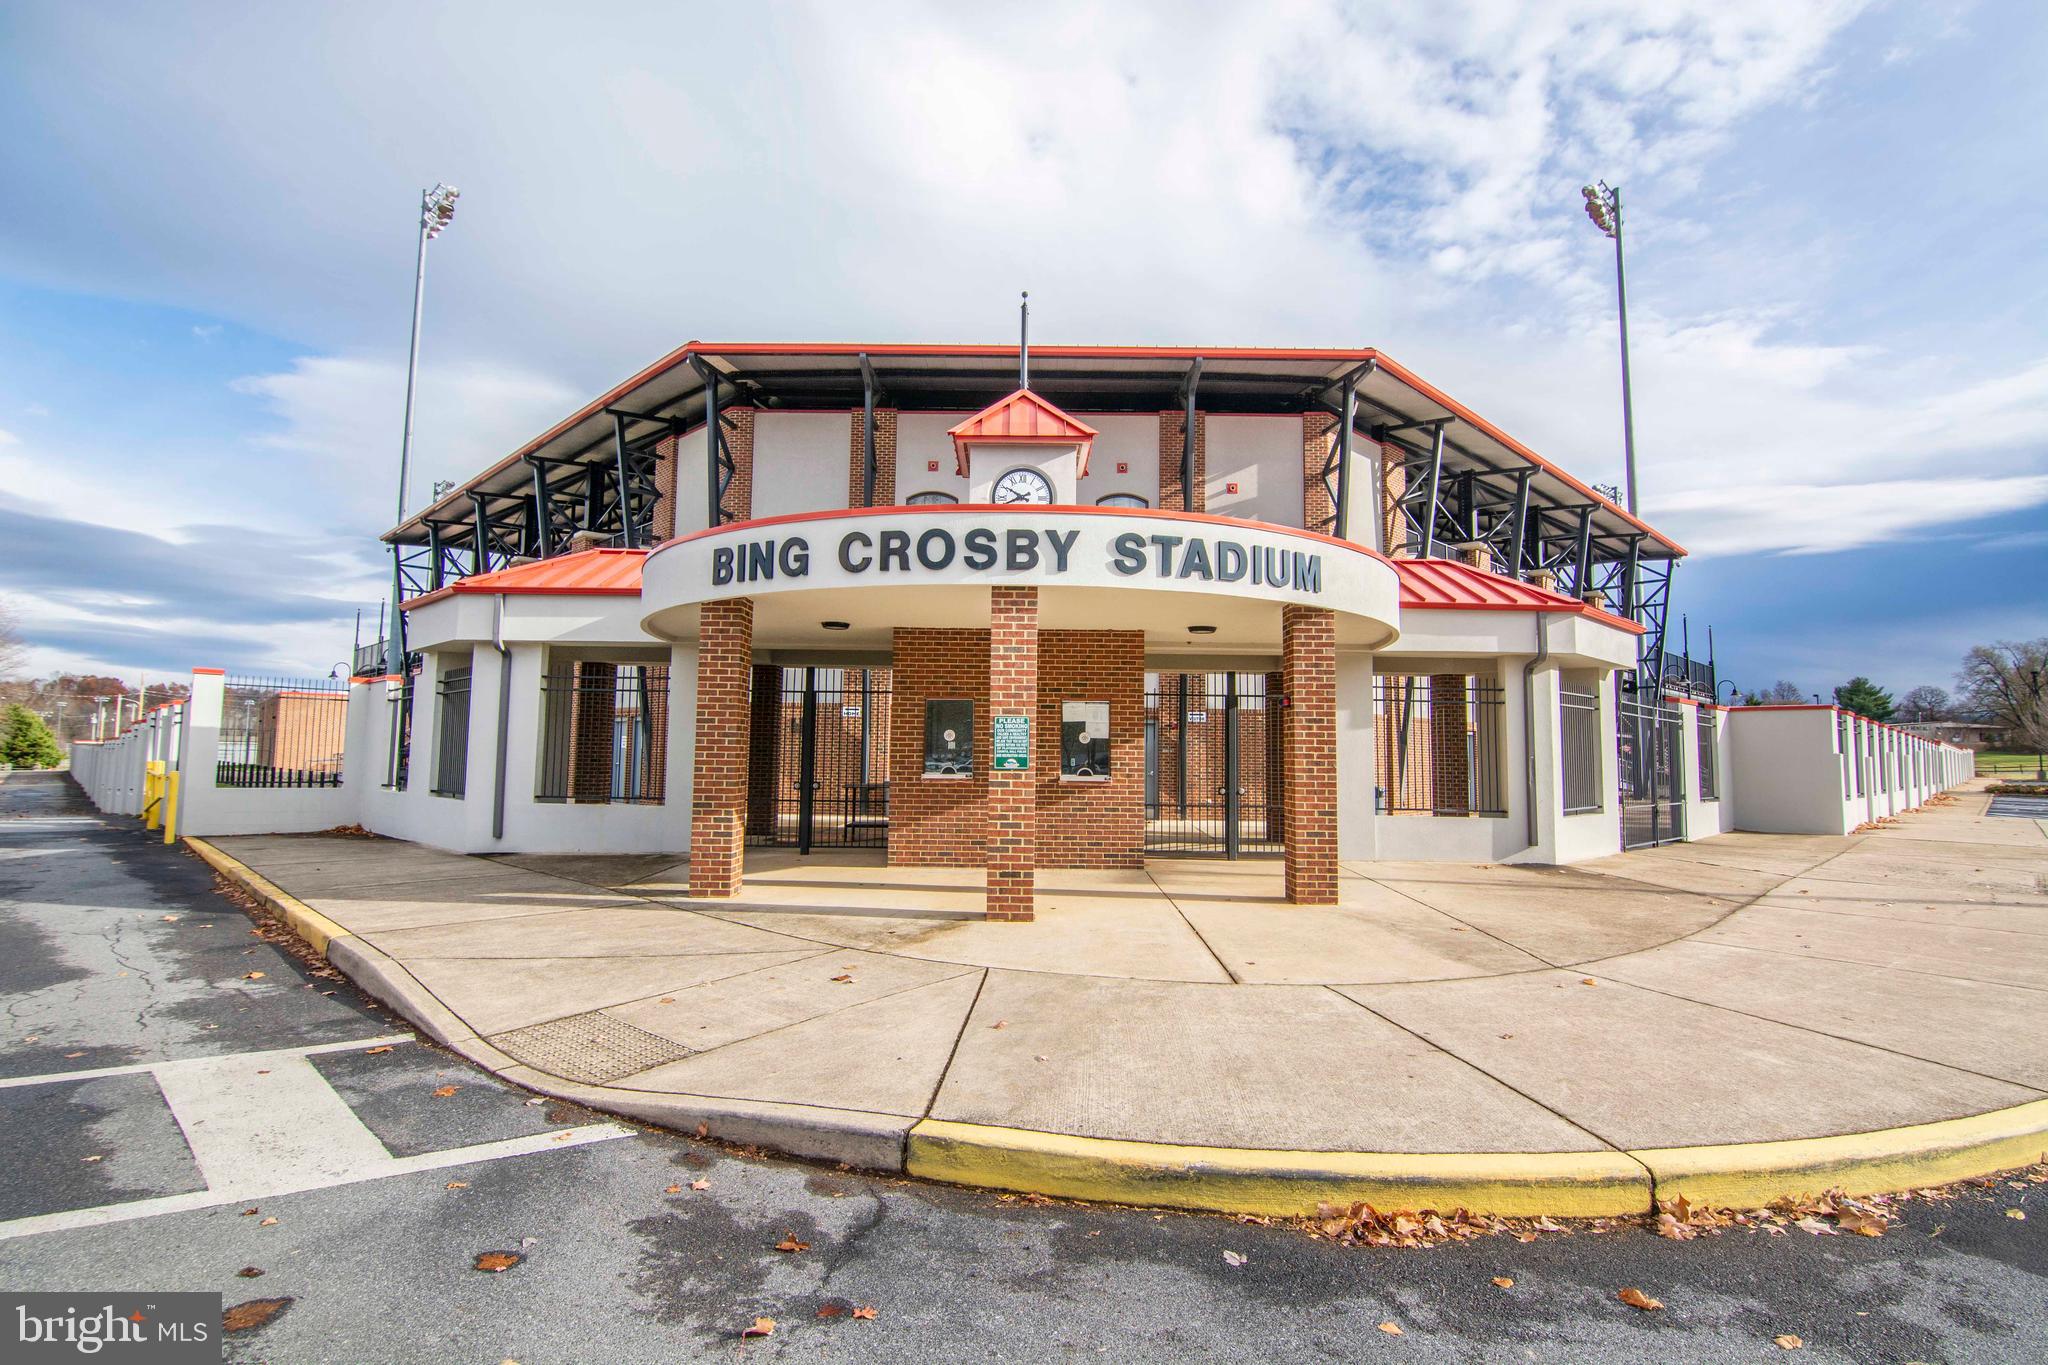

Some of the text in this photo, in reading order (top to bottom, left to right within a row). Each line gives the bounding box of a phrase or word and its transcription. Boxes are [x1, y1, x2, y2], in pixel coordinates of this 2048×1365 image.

[712, 528, 1323, 594] BING CROSBY STADIUM
